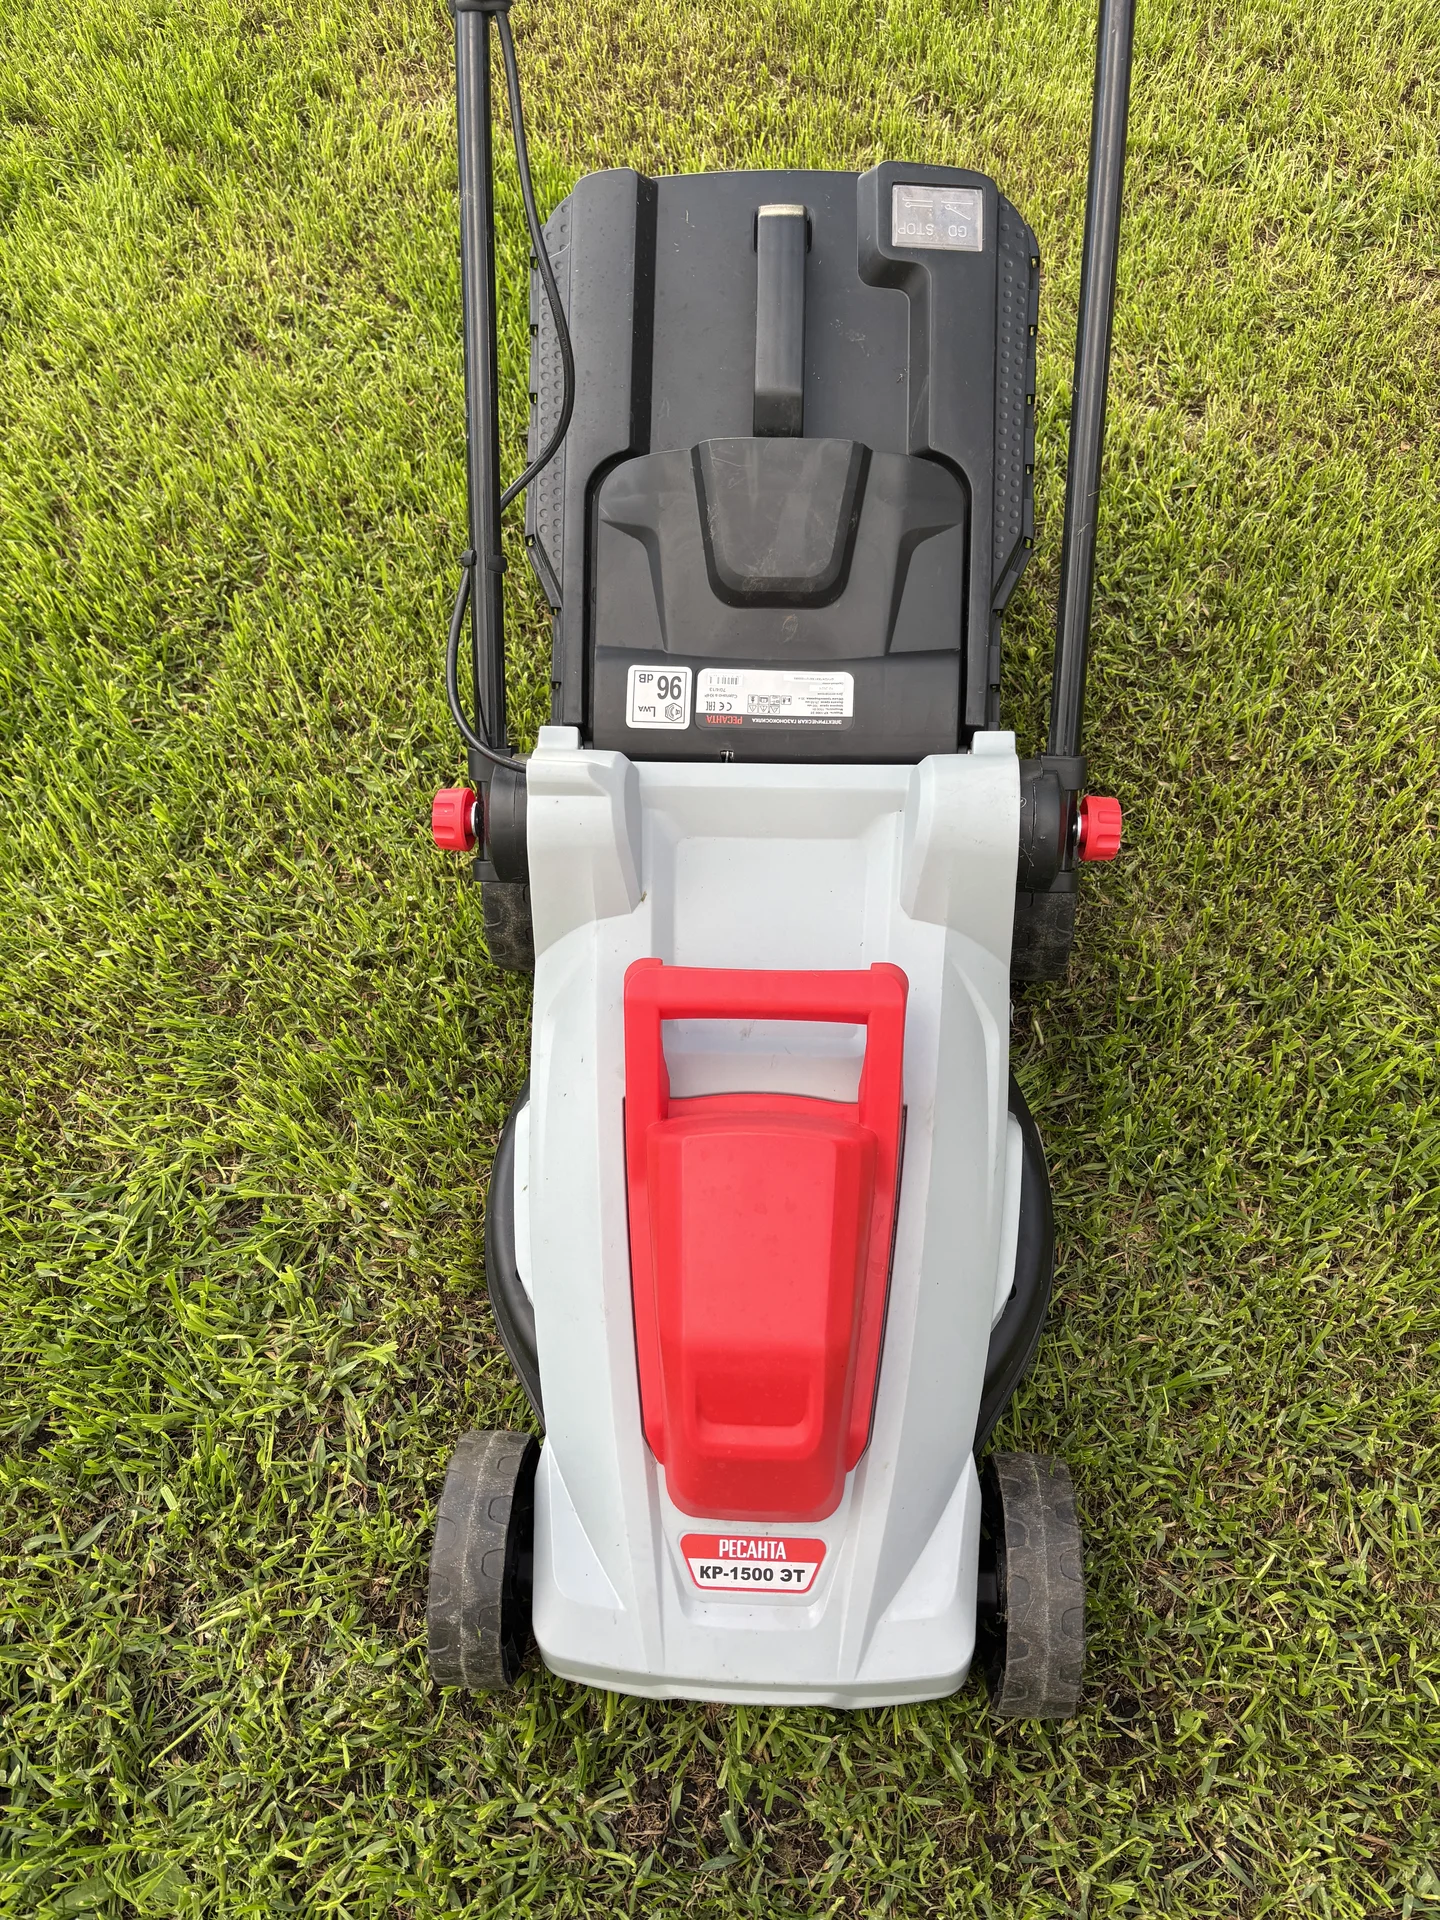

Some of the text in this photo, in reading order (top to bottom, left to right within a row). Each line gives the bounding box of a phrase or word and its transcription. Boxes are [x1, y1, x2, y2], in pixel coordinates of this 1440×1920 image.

[897, 222, 968, 238] GO STOP
[638, 674, 682, 700] 96 dB
[706, 715, 742, 724] РЕСАНТА
[718, 1539, 786, 1560] РЕСАНТА
[700, 1566, 806, 1582] КР-1500 ЭТ
